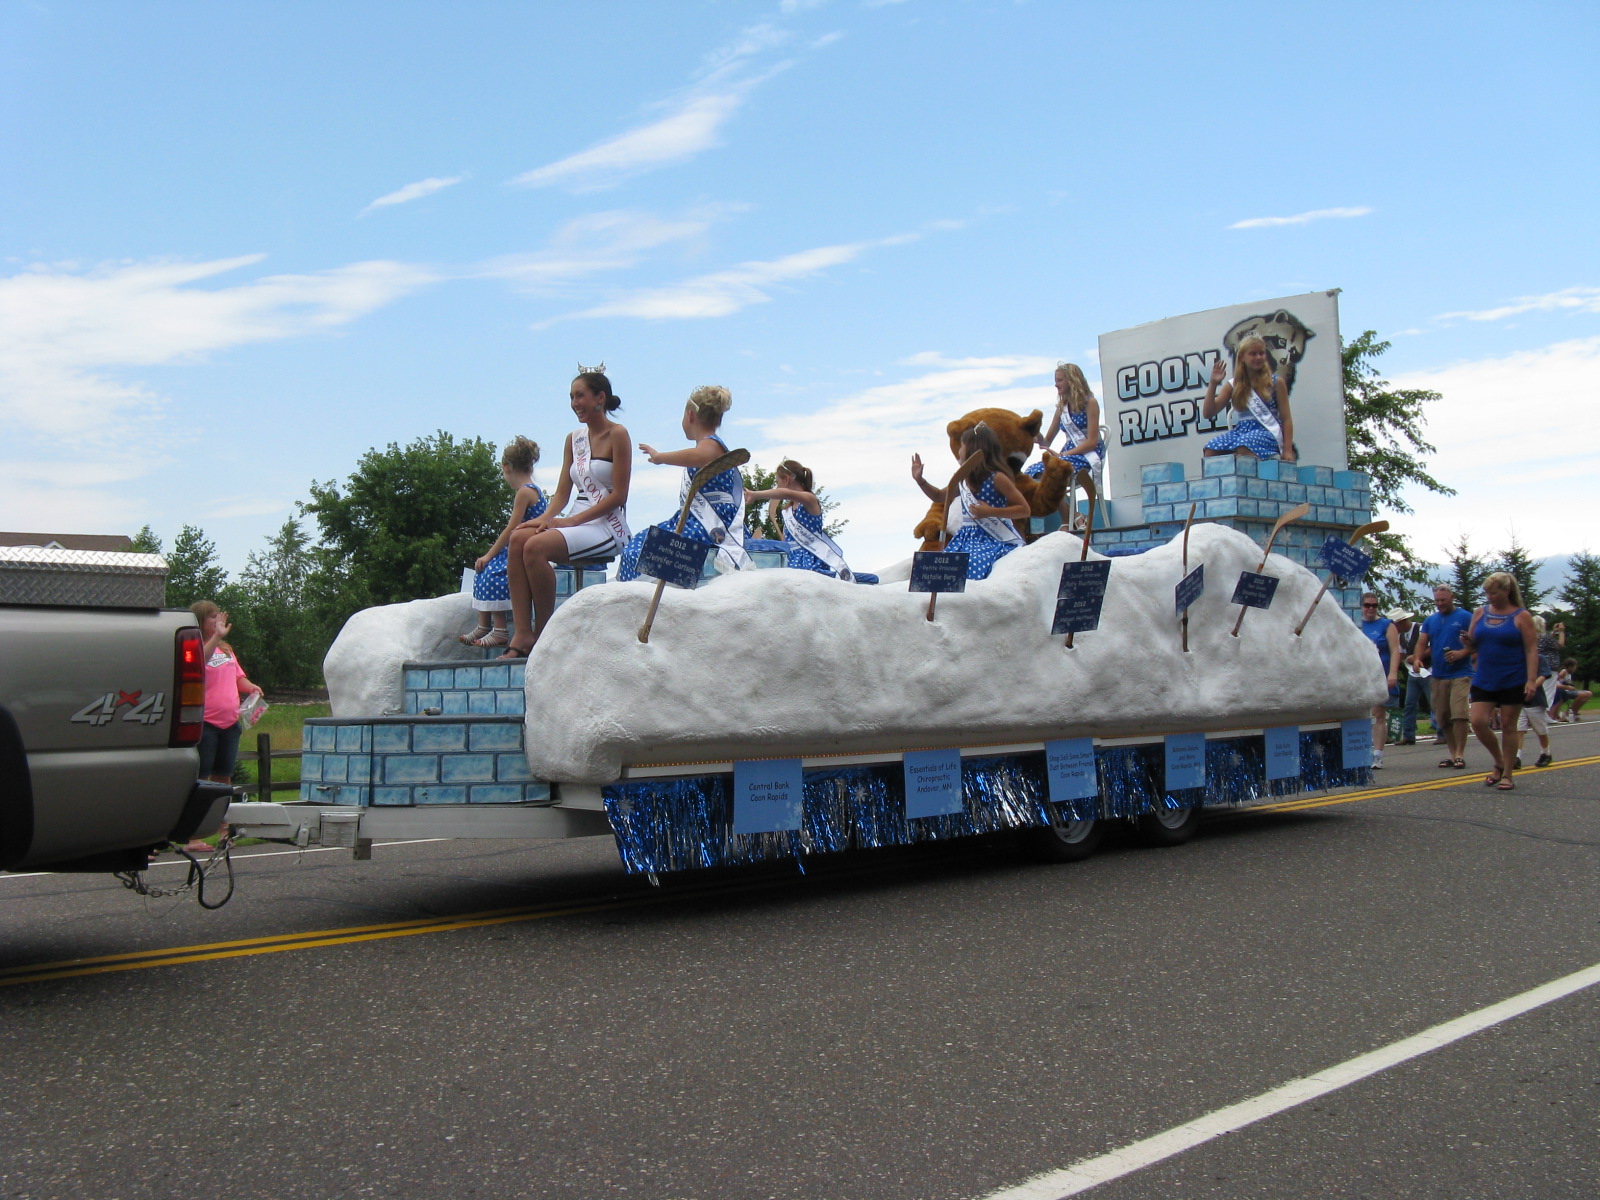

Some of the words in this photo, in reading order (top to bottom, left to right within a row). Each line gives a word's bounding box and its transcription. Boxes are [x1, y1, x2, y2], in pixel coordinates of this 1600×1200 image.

[1117, 349, 1221, 402] COON
[1119, 394, 1239, 446] RAPI
[606, 511, 626, 538] APIDS
[669, 538, 687, 551] 2012
[658, 545, 674, 555] Petite
[674, 550, 692, 561] Queen
[1341, 546, 1356, 558] 2012
[645, 551, 673, 566] Jennifer
[673, 561, 696, 575] Carlson
[934, 556, 950, 564] 2012
[943, 573, 956, 582] Berg
[1049, 755, 1060, 763] Shop
[909, 765, 938, 774] Essentials
[937, 762, 944, 771] of
[945, 762, 957, 771] Life
[1049, 763, 1060, 771] Just
[1060, 762, 1079, 770] Between
[1078, 760, 1094, 768] Friends
[916, 774, 951, 784] Chiropractic
[1060, 771, 1071, 779] Coon
[1071, 770, 1085, 779] Rapids
[748, 781, 773, 791] Central
[774, 781, 790, 790] Bank
[941, 783, 953, 791] MN
[750, 793, 766, 802] Coon
[767, 792, 788, 803] Rapids
